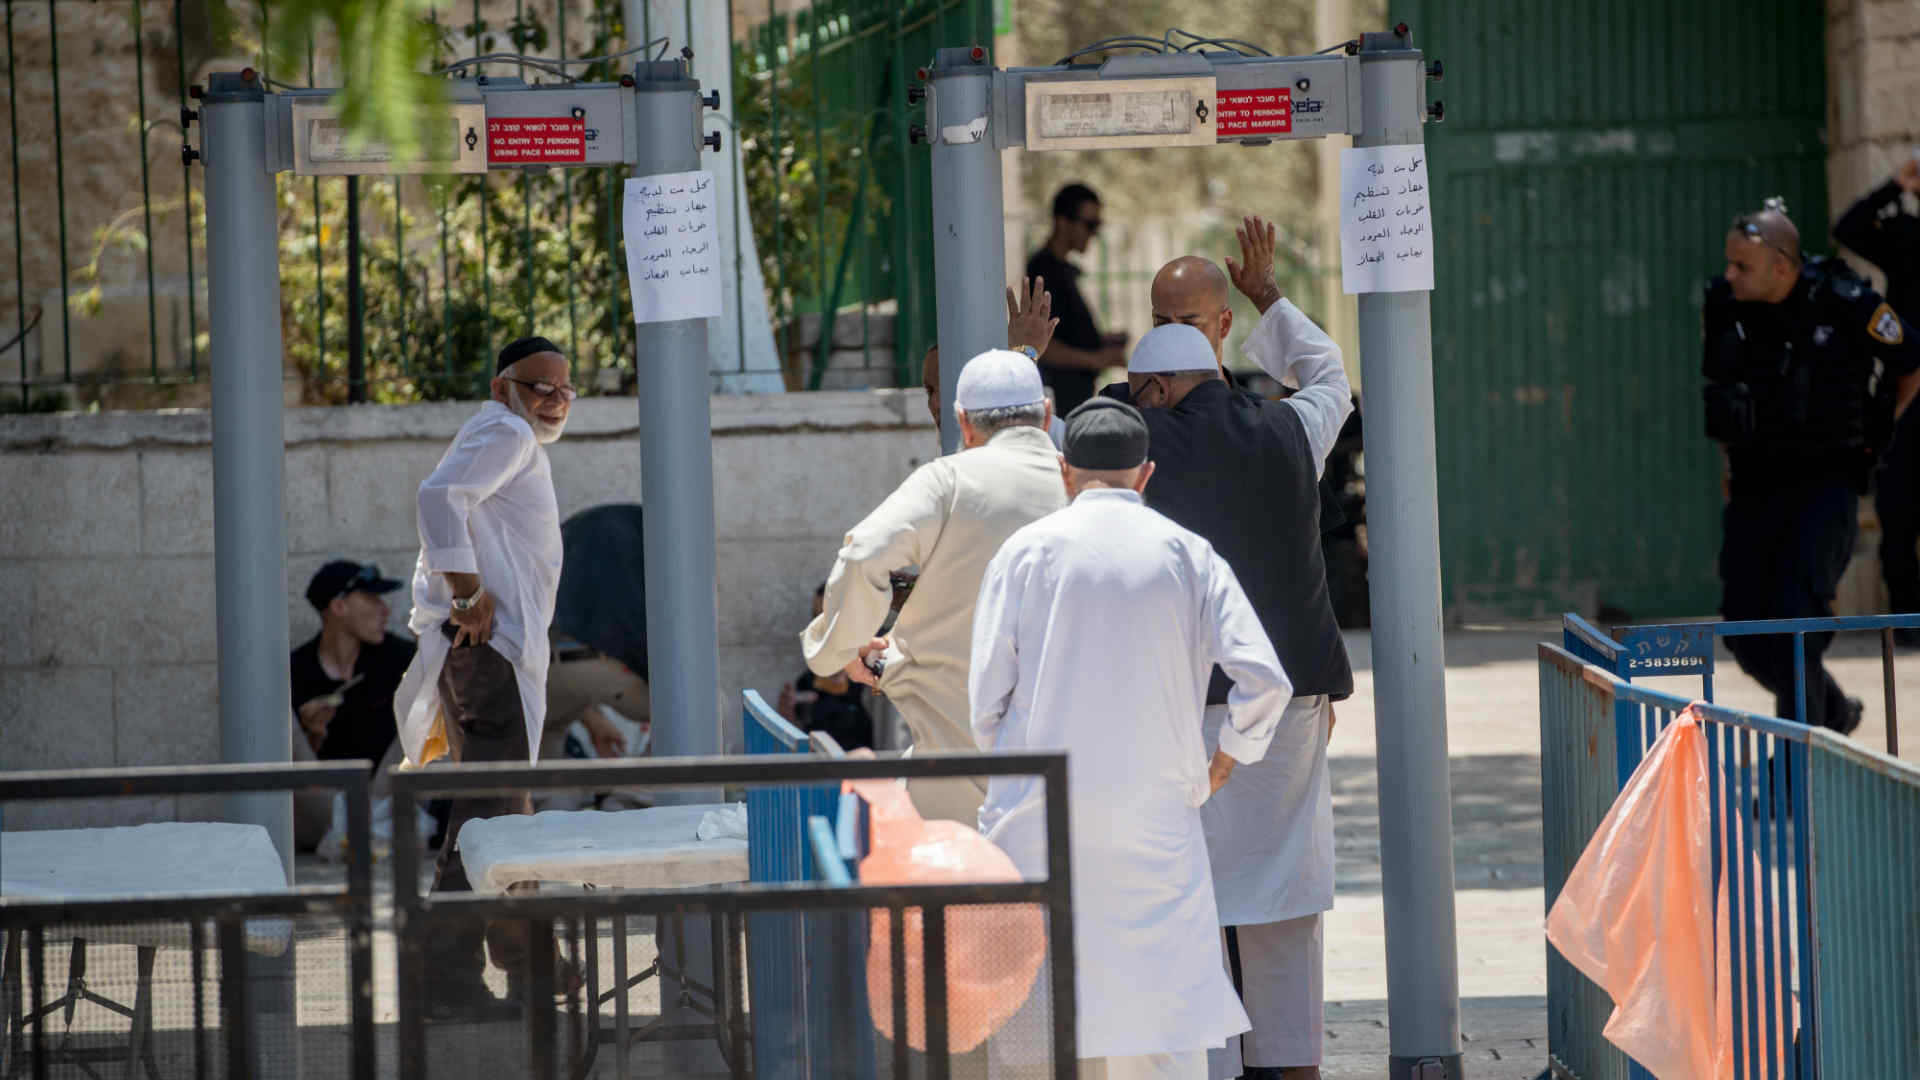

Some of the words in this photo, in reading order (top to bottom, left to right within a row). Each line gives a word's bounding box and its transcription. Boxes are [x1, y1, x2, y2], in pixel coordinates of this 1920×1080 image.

[1256, 95, 1275, 103] מעבר
[1278, 95, 1289, 103] אין
[1253, 109, 1286, 117] PERSONS
[490, 123, 500, 132] לב
[550, 123, 569, 131] מעבר
[572, 124, 583, 132] אין
[1228, 121, 1247, 129] PACE
[1251, 120, 1286, 128] MARKERS
[508, 137, 530, 145] ENTRY
[534, 137, 543, 145] TO
[546, 137, 580, 145] PERSONS
[494, 149, 518, 157] USING
[544, 148, 580, 156] MARKERS
